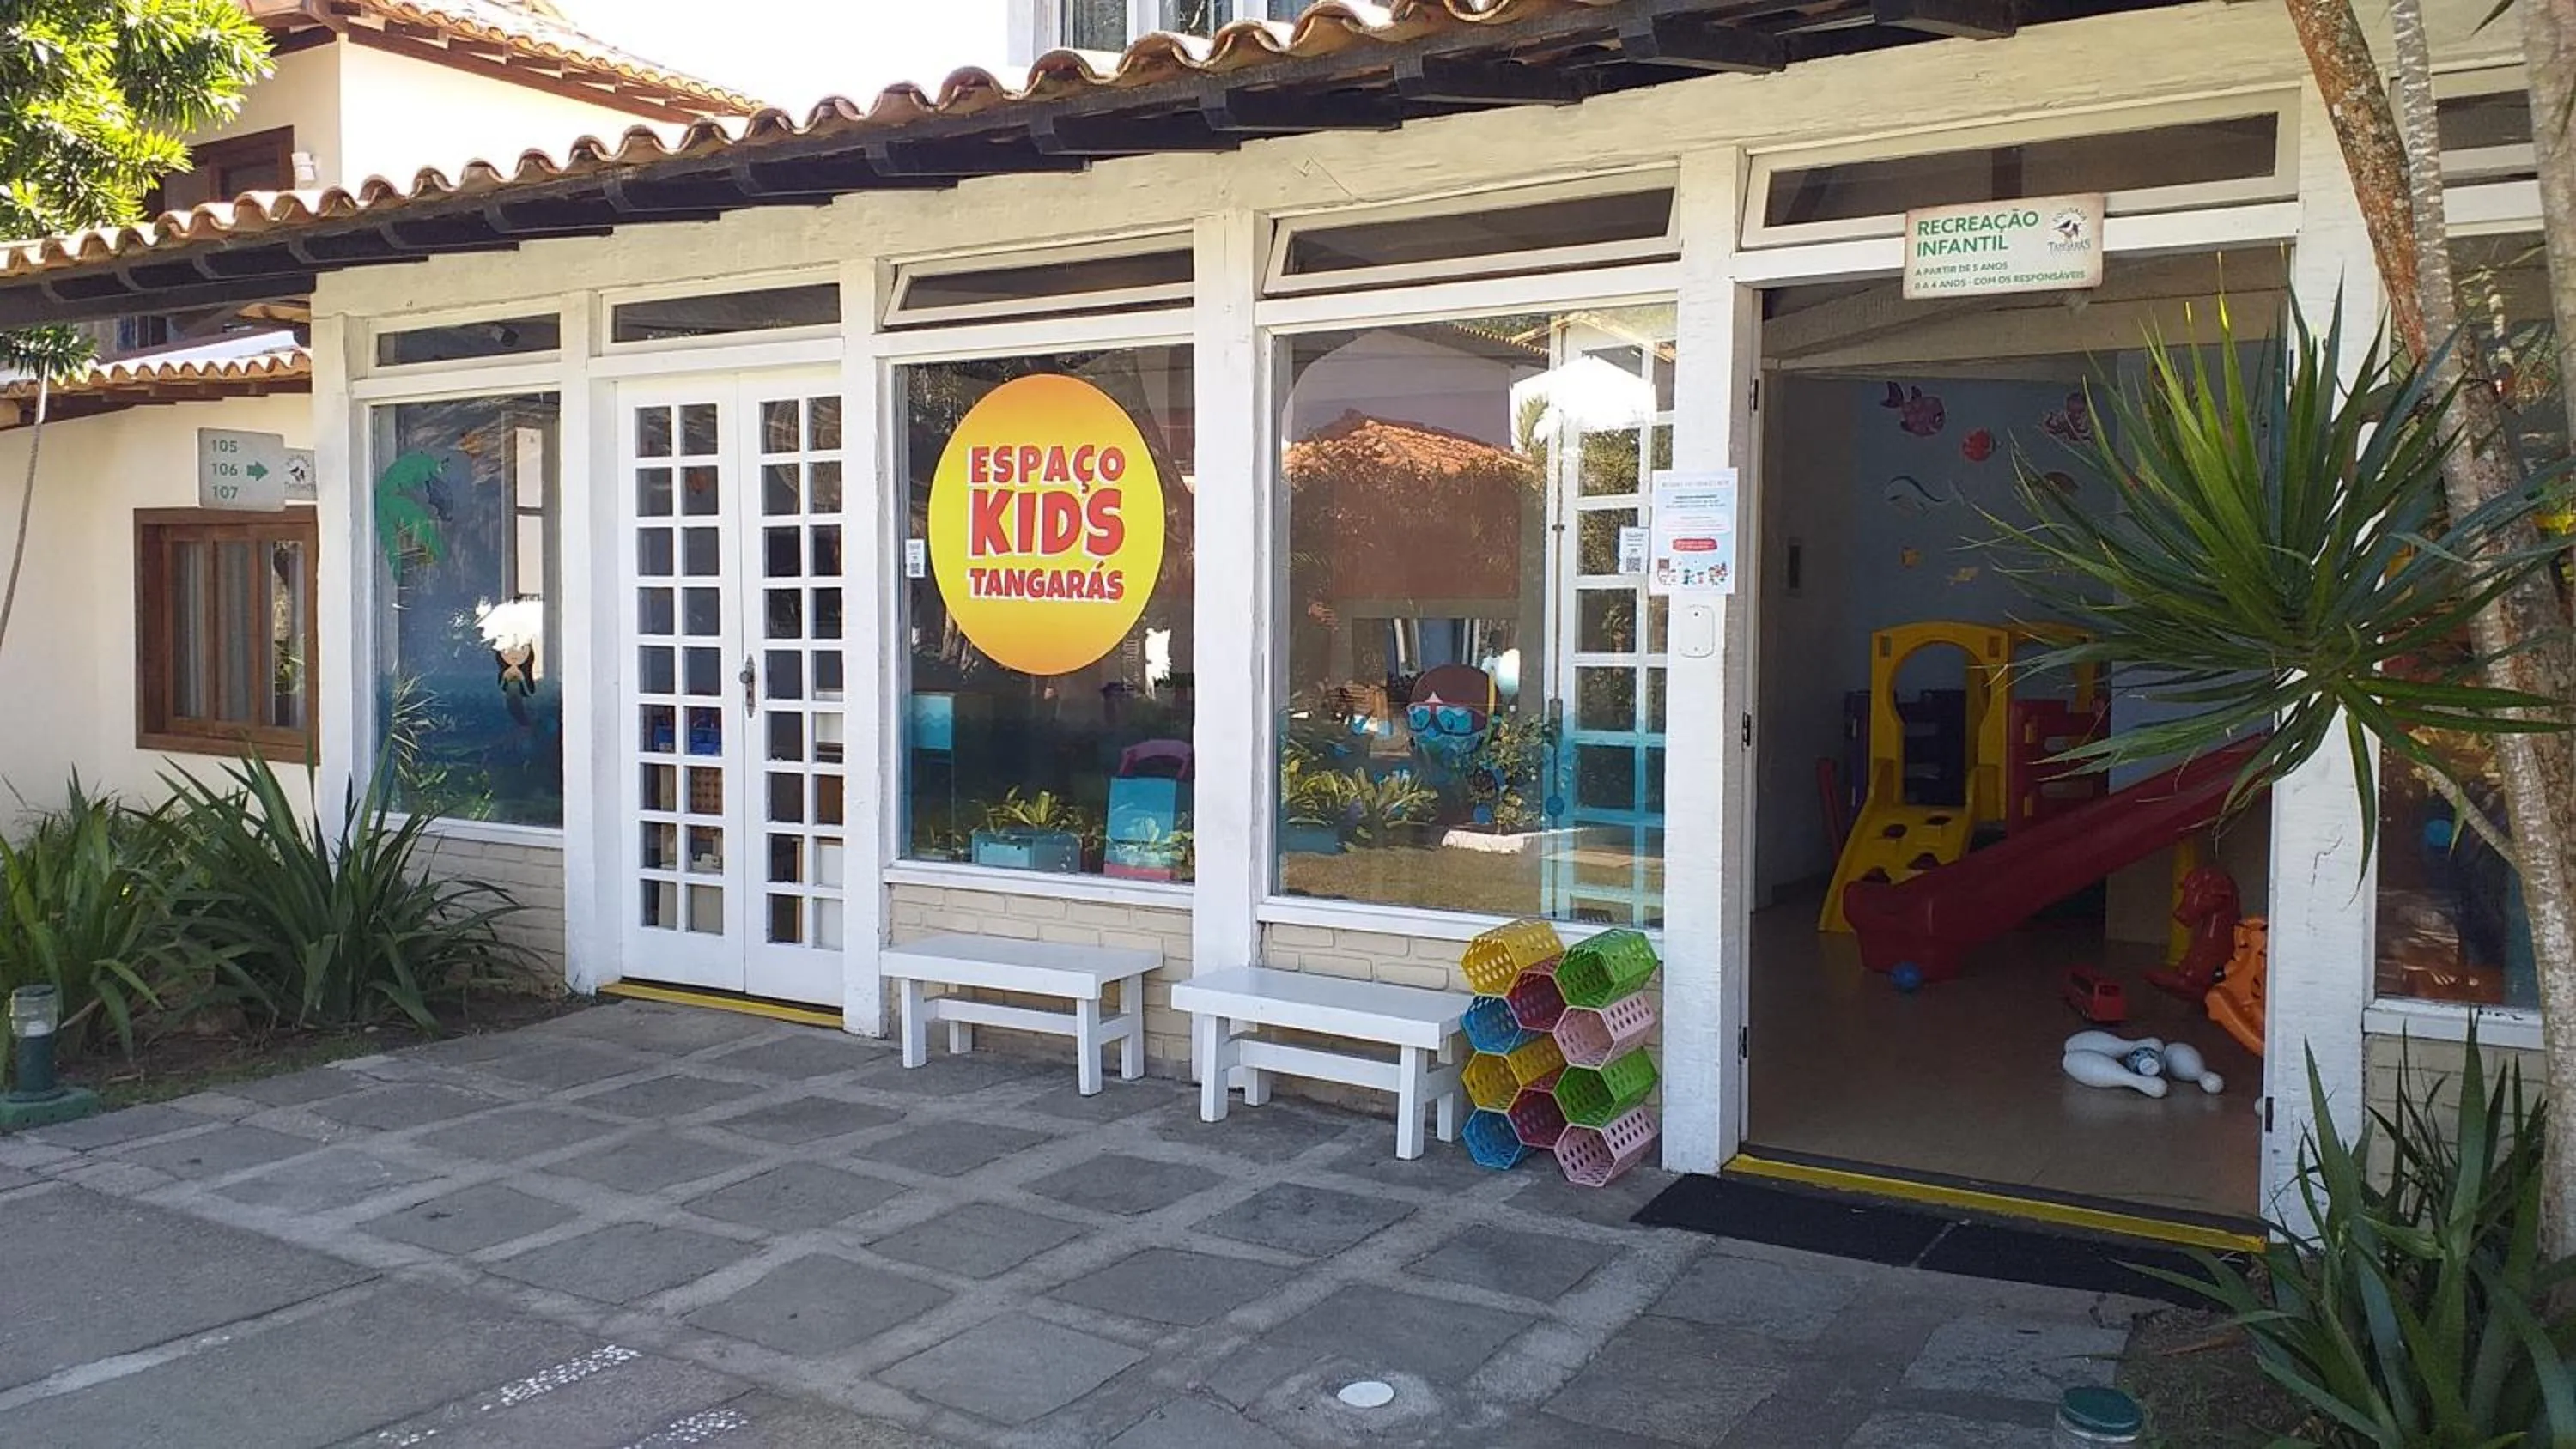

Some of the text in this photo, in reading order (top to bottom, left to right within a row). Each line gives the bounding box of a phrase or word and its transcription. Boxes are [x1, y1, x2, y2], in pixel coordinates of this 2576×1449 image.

[1917, 209, 2039, 236] RECREAÇÃO
[1917, 236, 2008, 257] INFANTIL
[1923, 266, 1957, 275] PARTIR
[1959, 264, 1971, 273] DE
[1981, 261, 2008, 270] ANOS
[1940, 278, 1966, 288] ANOS
[1974, 276, 1996, 285] COM
[1998, 275, 2011, 284] OS
[211, 439, 238, 452] 105
[210, 462, 239, 476] 106
[969, 444, 1127, 494] ESPAÇO
[212, 486, 239, 499] 107
[969, 487, 1127, 558] KIDS
[969, 562, 1126, 601] TANGARÁS
